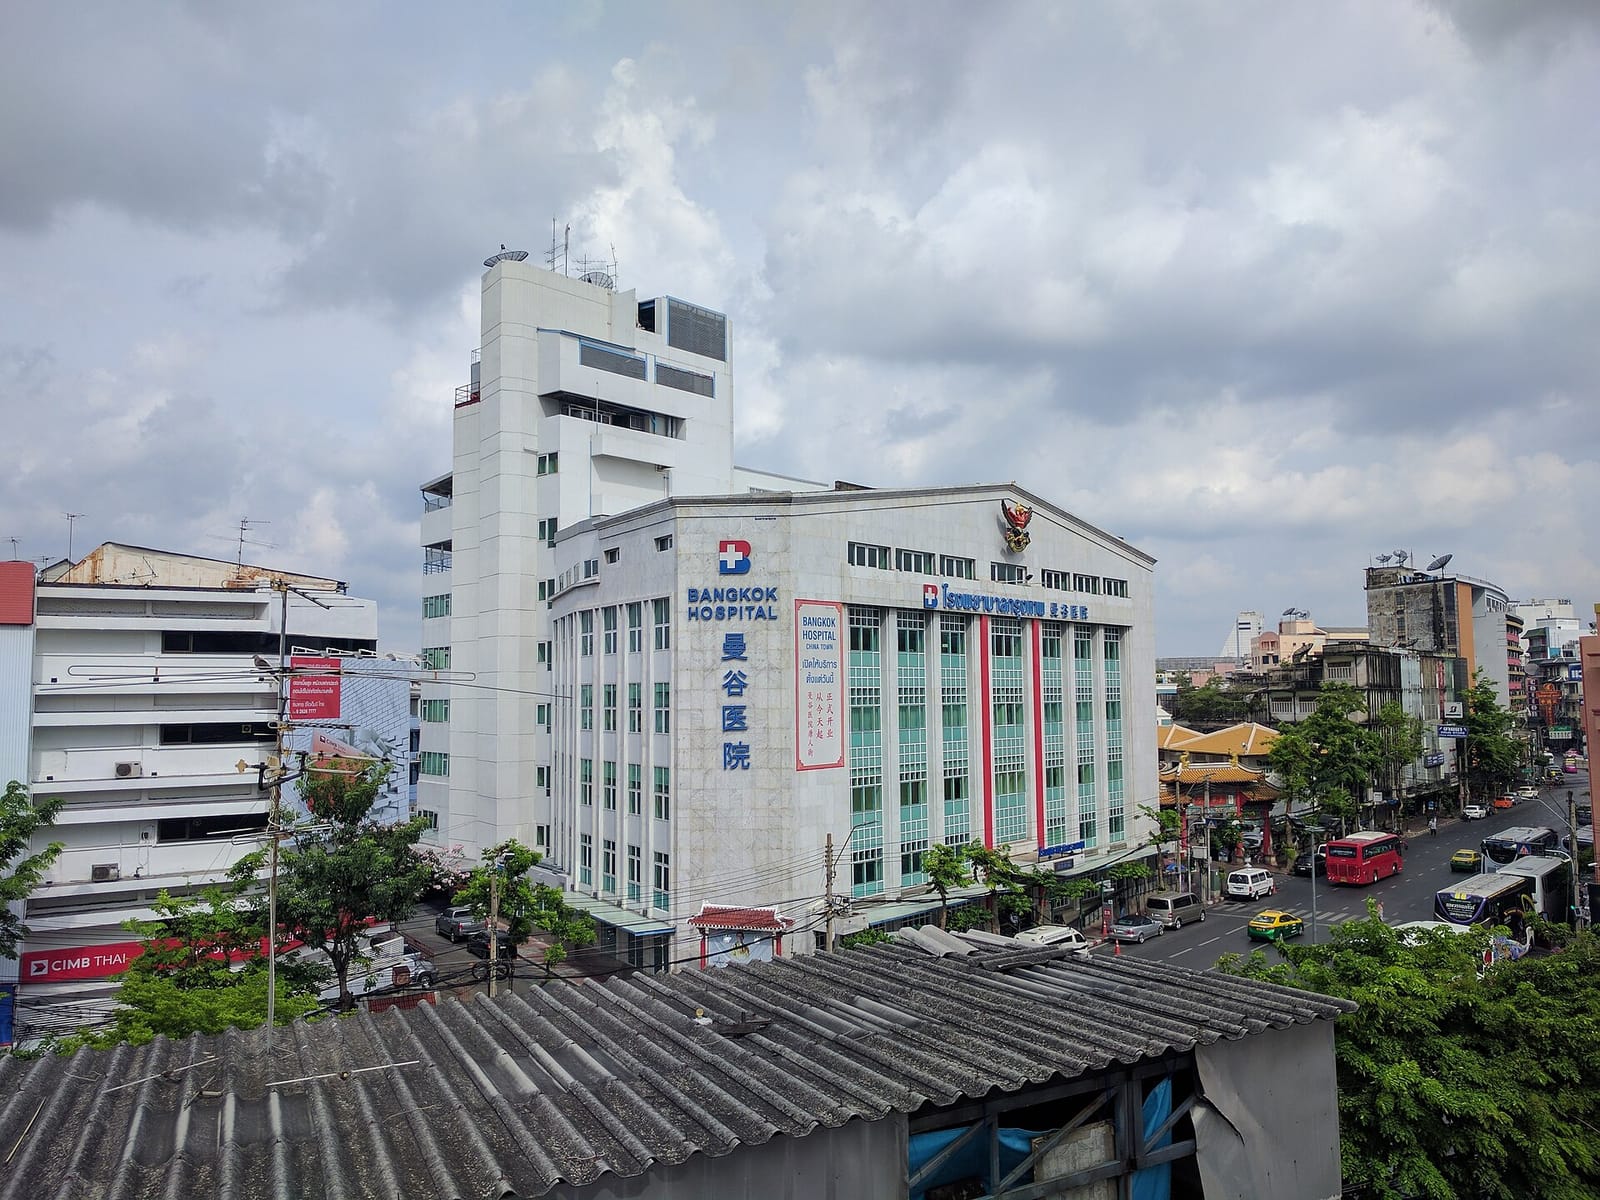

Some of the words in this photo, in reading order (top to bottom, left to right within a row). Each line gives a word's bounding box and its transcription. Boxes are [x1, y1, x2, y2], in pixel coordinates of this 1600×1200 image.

[688, 587, 778, 603] BANGKOK
[688, 606, 778, 621] HOSPITAL
[802, 616, 836, 627] BANGKOK
[802, 630, 836, 640] HOSPITAL
[721, 633, 750, 771] 曼谷医院
[51, 957, 90, 971] CIMB
[93, 953, 126, 967] THAI
